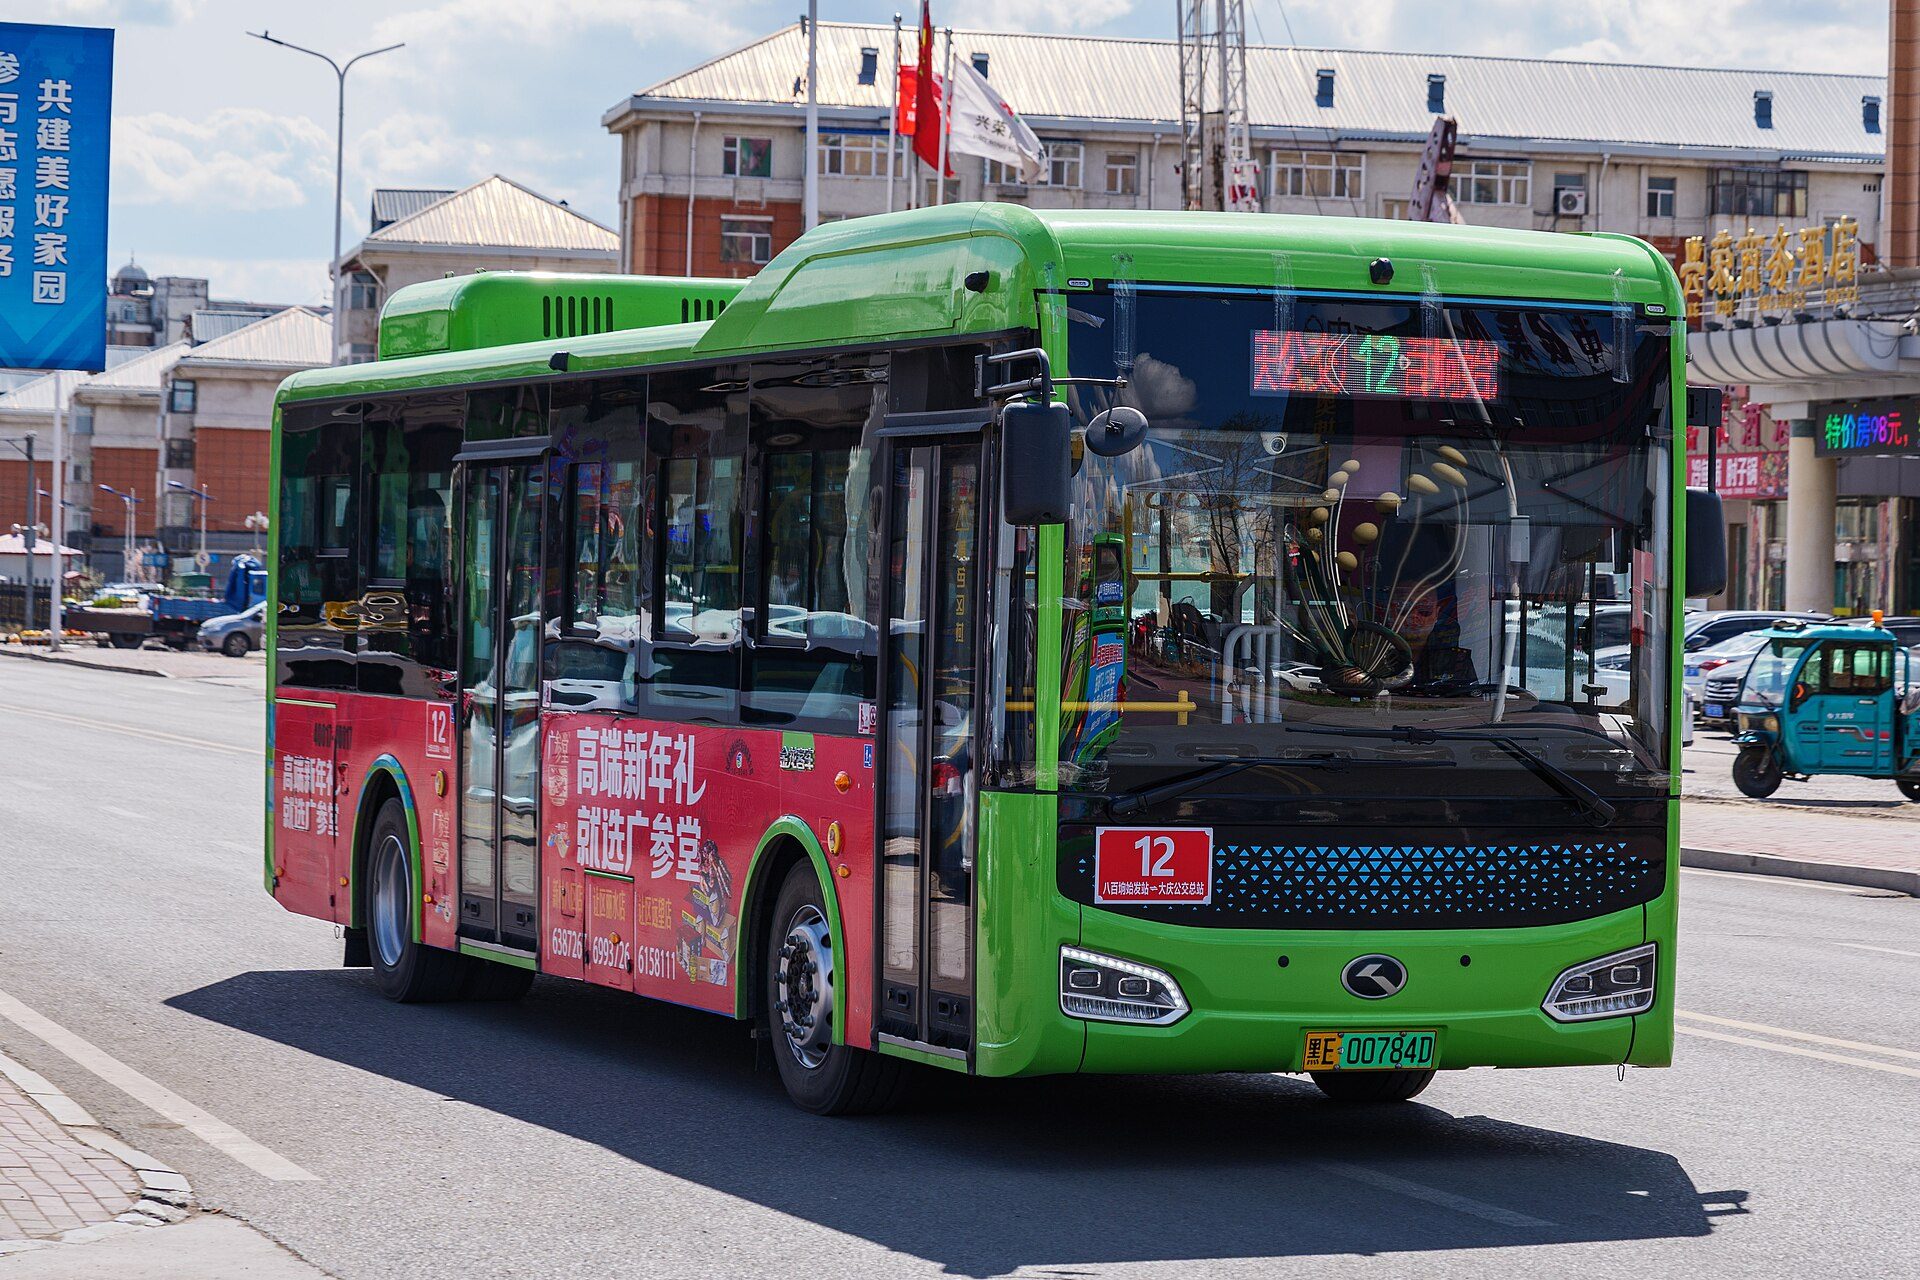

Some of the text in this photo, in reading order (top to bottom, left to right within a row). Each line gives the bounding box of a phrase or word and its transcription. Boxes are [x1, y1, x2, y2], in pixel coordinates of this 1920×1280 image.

[33, 79, 72, 304] 共建美好家园
[1358, 334, 1399, 394] 12
[431, 710, 446, 743] 12
[576, 727, 707, 806] 高端新年礼
[576, 806, 701, 883] 就选广参堂
[1134, 835, 1175, 877] 12
[1158, 881, 1205, 896] 大庆公交总站
[638, 945, 676, 980] 6158111
[1307, 1036, 1433, 1065] 黑E 00784D
